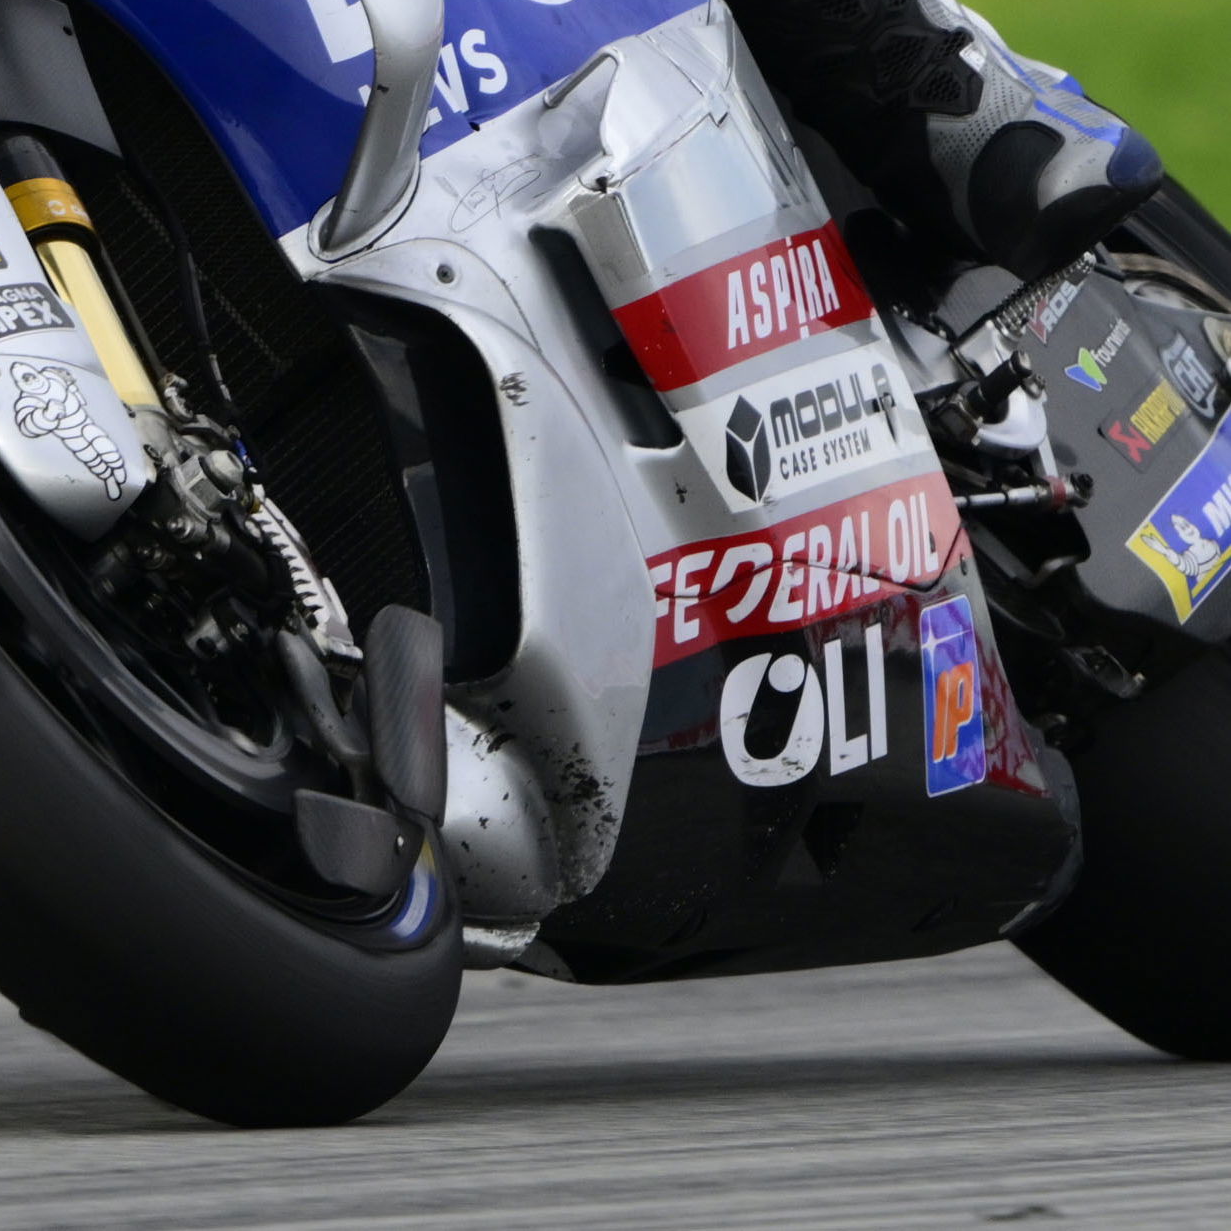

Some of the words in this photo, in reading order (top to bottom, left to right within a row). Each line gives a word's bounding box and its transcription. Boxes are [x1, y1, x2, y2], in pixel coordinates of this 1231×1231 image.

[779, 447, 818, 481] CASE
[822, 427, 872, 466] SYSTEM
[654, 511, 881, 645] FEDERAL
[887, 492, 940, 583] OIL
[932, 660, 975, 763] IP
